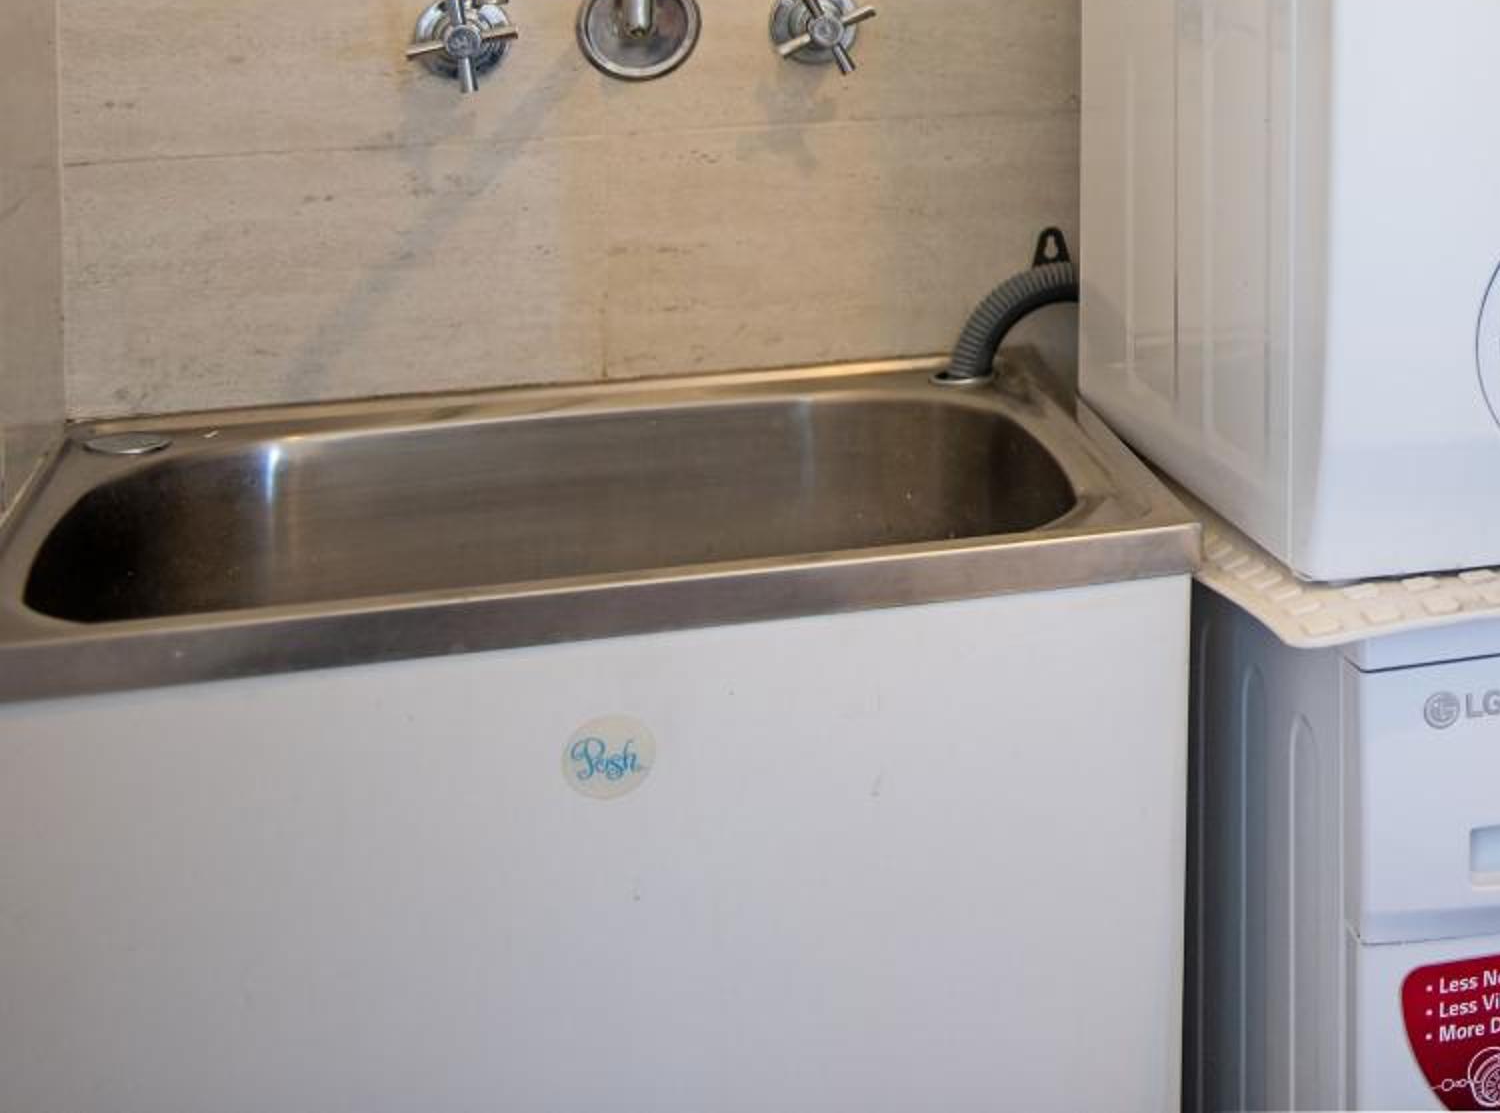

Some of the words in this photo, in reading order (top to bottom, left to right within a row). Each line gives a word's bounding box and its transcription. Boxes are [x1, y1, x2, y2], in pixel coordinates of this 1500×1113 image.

[1438, 976, 1478, 994] Less
[1438, 999, 1478, 1018] Less
[1438, 1023, 1485, 1043] More
